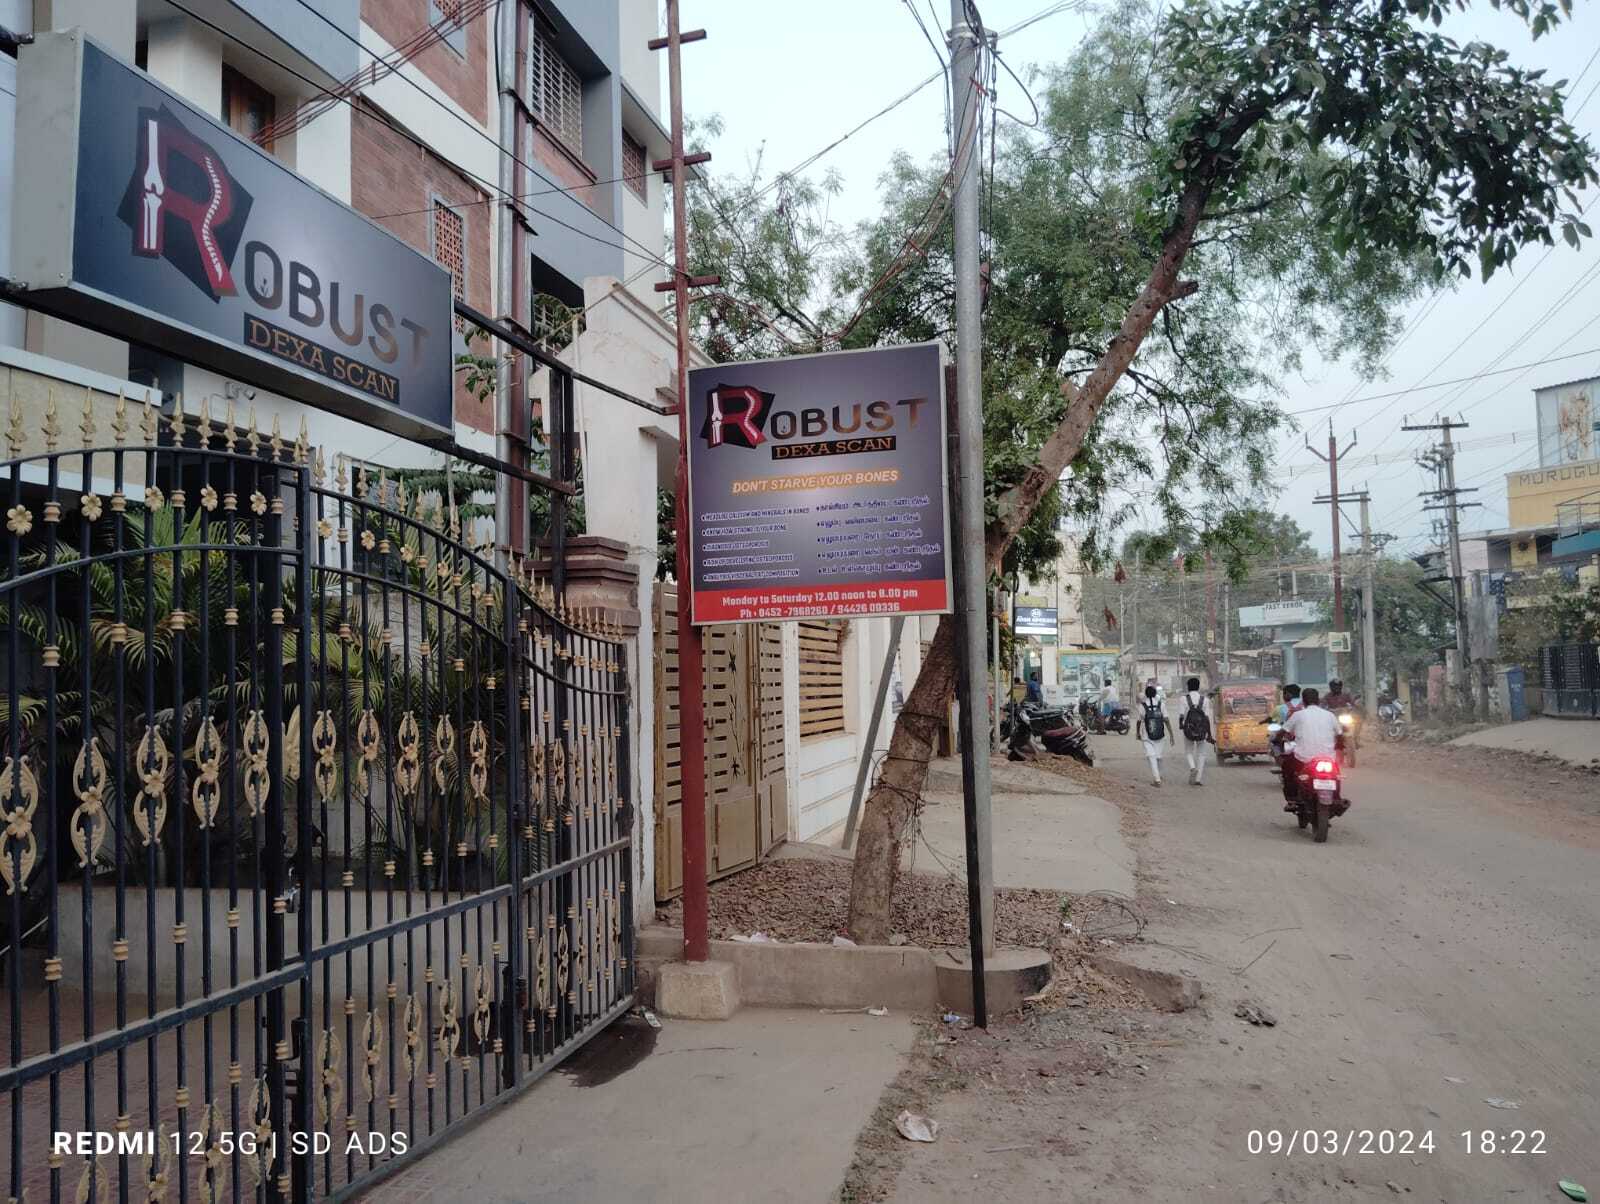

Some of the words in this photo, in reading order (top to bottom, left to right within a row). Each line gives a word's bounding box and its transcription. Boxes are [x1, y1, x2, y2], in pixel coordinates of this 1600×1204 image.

[134, 110, 430, 370] ROBUST
[250, 319, 325, 375] DEXA
[333, 357, 397, 400] SCAN
[708, 386, 928, 449] ROBUST
[775, 443, 835, 459] DEXA
[841, 437, 893, 451] SCAN
[732, 480, 768, 493] DON'T
[771, 476, 816, 490] STARVE
[817, 474, 852, 487] YOUR
[855, 470, 899, 484] BONES
[722, 595, 758, 607] Monday
[760, 594, 769, 604] to
[771, 592, 813, 605] Saturday
[815, 591, 839, 602] 12.00
[841, 591, 865, 600] noon
[867, 590, 876, 599] to
[903, 589, 918, 600] pm
